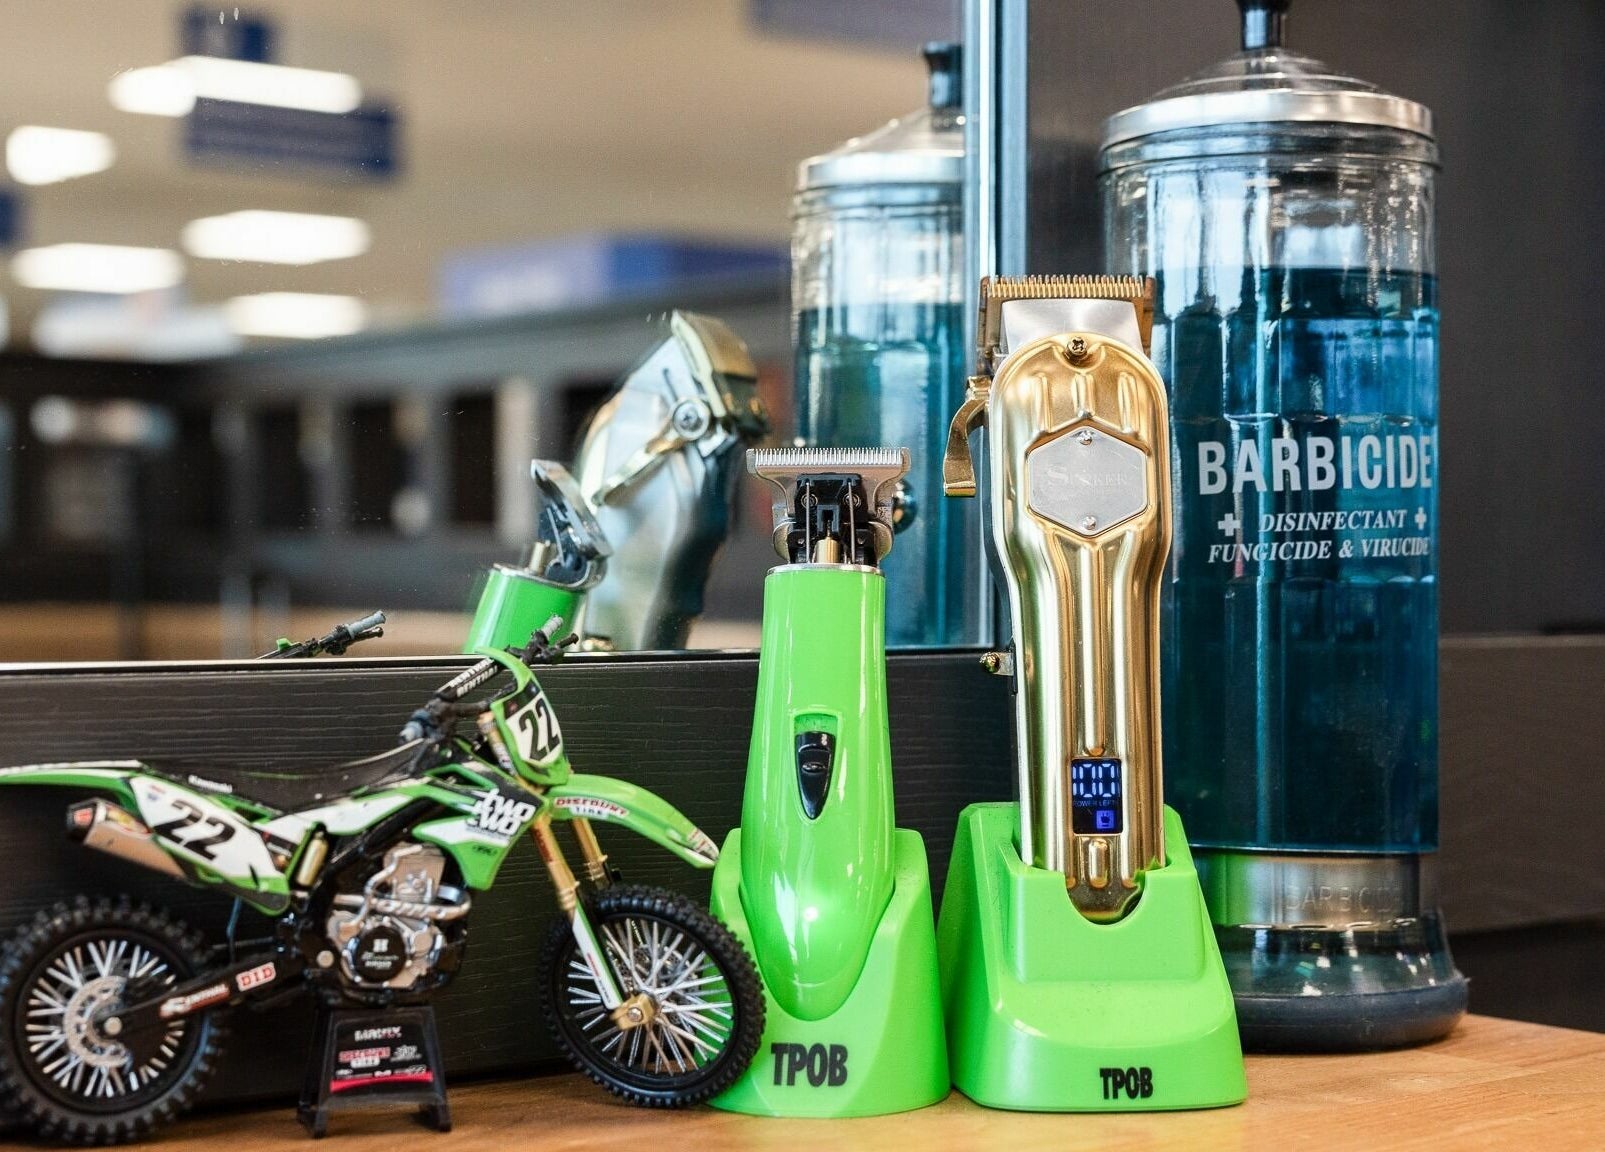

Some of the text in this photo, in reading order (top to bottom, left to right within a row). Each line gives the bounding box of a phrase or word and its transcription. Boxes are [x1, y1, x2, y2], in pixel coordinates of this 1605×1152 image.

[1198, 434, 1432, 495] BARBICIDE
[1258, 509, 1408, 532] DISINFECTANT
[1207, 537, 1431, 563] FUNGICIDE & VIRUCIDE
[518, 696, 560, 762] 22
[152, 799, 236, 861] 22
[771, 1042, 848, 1088] TPOB
[1100, 1066, 1153, 1099] TPOB
